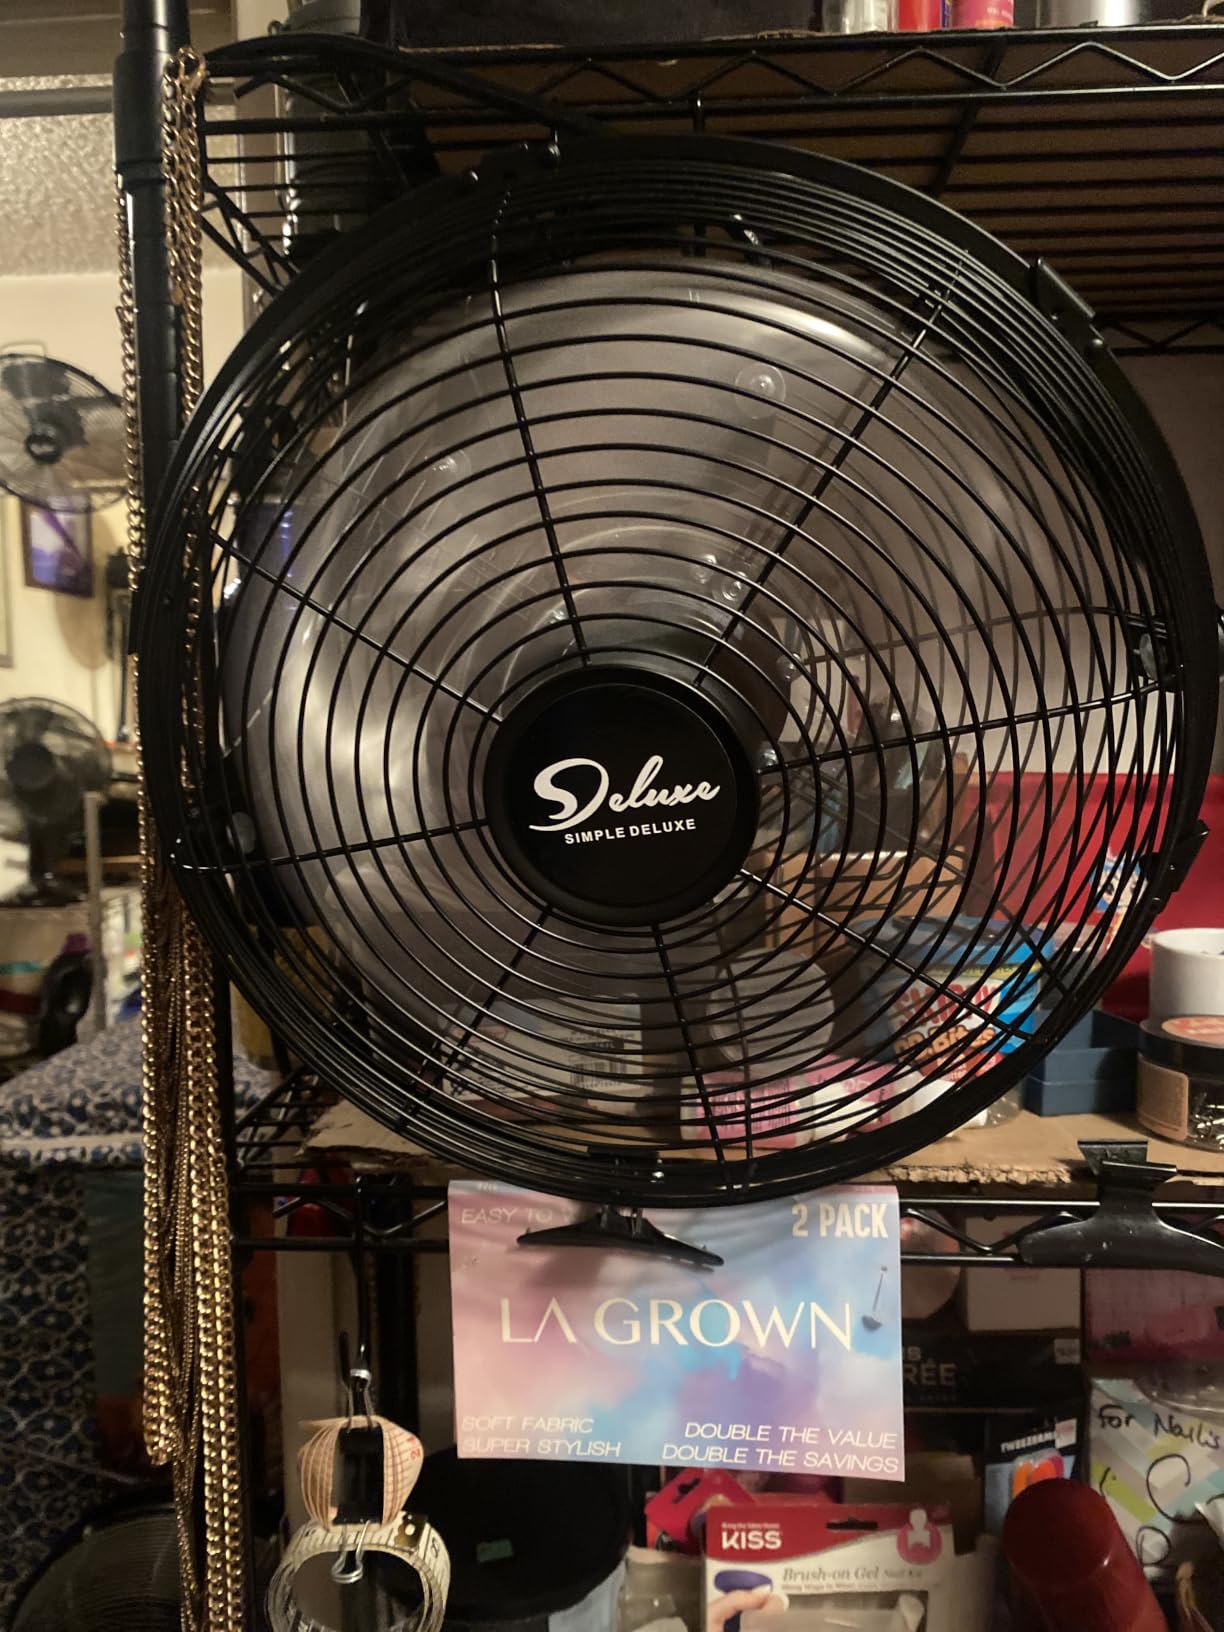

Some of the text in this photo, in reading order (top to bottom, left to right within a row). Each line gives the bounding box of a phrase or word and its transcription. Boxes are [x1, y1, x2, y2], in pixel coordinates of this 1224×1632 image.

[564, 818, 697, 845] SIMPLE DELUXE
[461, 1208, 517, 1225] EASY
[791, 1203, 889, 1239] 2 PACK
[501, 1297, 852, 1351] LA GROWN
[461, 1416, 594, 1434] SOFT FABRIC
[1098, 1403, 1136, 1430] For
[462, 1437, 622, 1458] SUPER STYLISH
[684, 1421, 898, 1450] DOUBLE THE VALUE
[661, 1443, 899, 1474] DOUBLE THE SAVINGS
[721, 1530, 783, 1551] KISS
[783, 1567, 852, 1581] Brush-on
